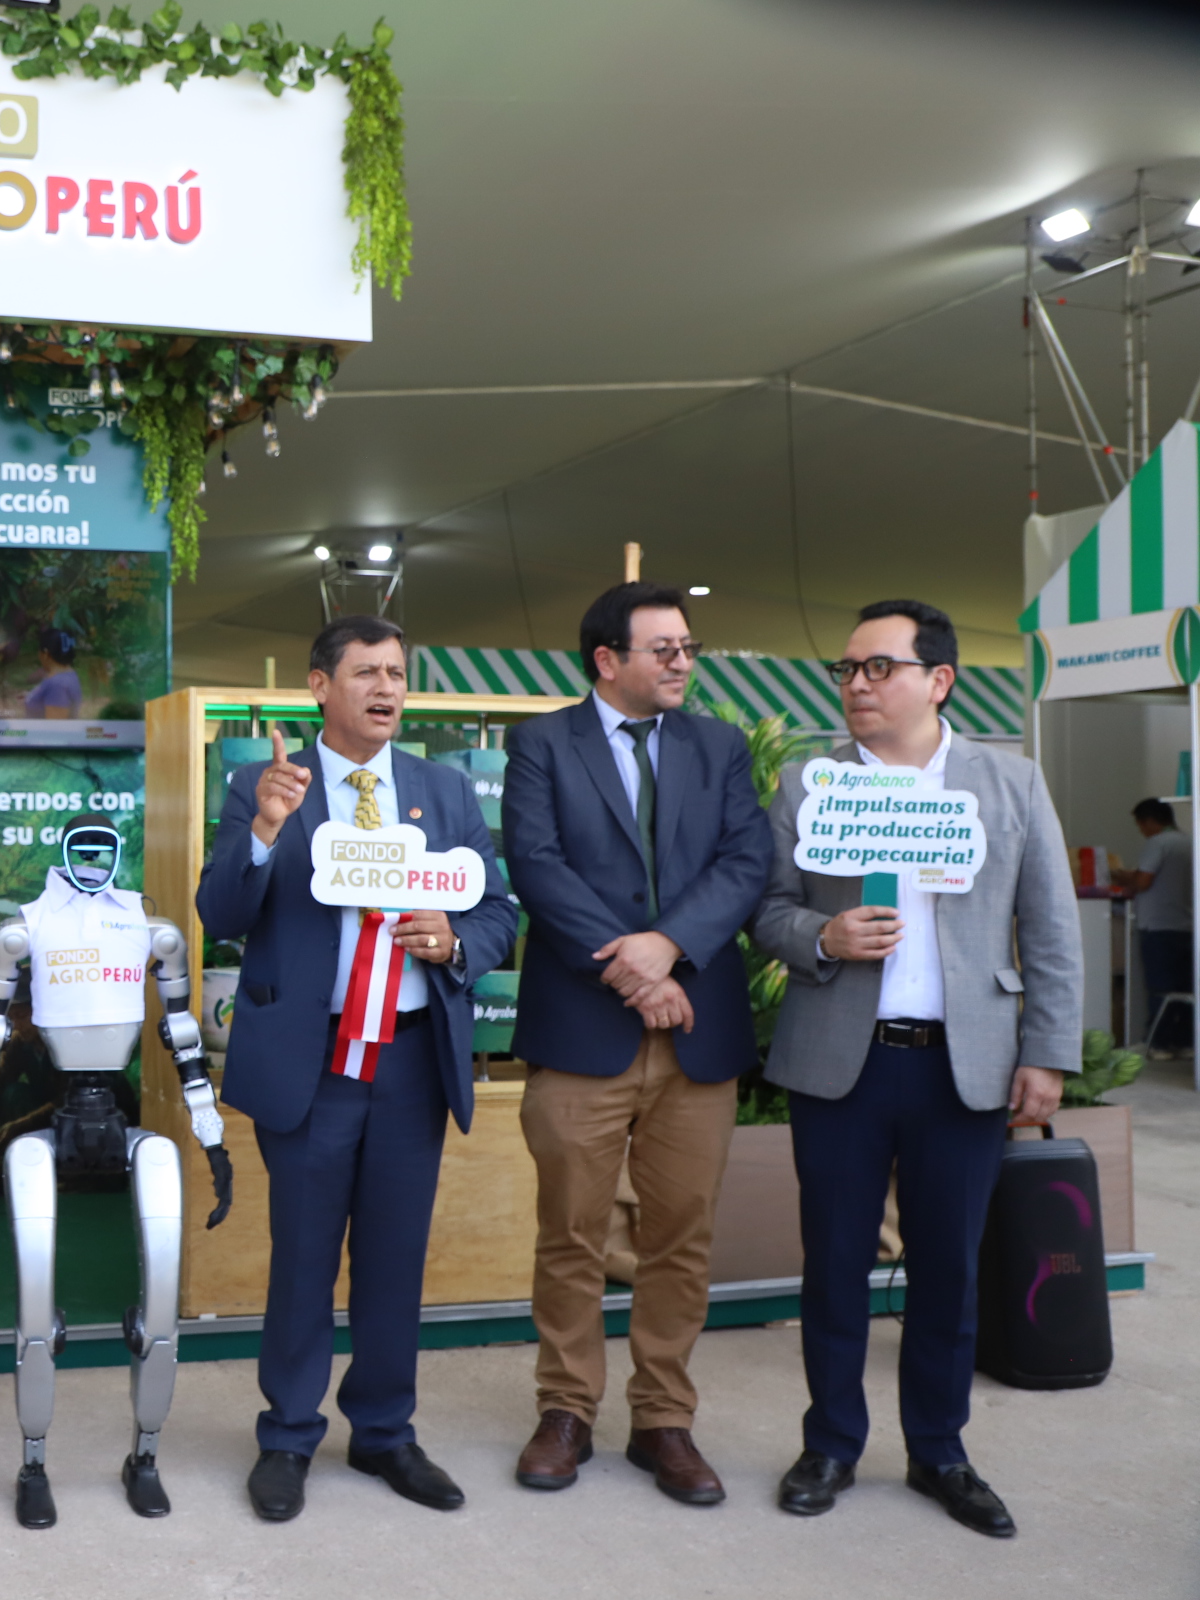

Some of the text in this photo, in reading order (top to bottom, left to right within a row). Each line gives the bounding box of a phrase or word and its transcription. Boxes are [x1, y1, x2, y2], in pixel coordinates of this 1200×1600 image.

[1112, 644, 1162, 662] COFFEE
[837, 771, 916, 791] Agrobanco
[818, 796, 966, 817] ¡Impulsamos
[2, 826, 34, 846] SU
[811, 820, 972, 841] tu producción
[333, 842, 402, 862] FONDO
[807, 846, 975, 867] agropecauria!
[330, 866, 466, 893] AGROPERÚ
[47, 949, 98, 965] FONDO
[48, 963, 142, 985] AGROPERÚ
[484, 1004, 517, 1022] Agroba
[1050, 1252, 1082, 1275] JBL
